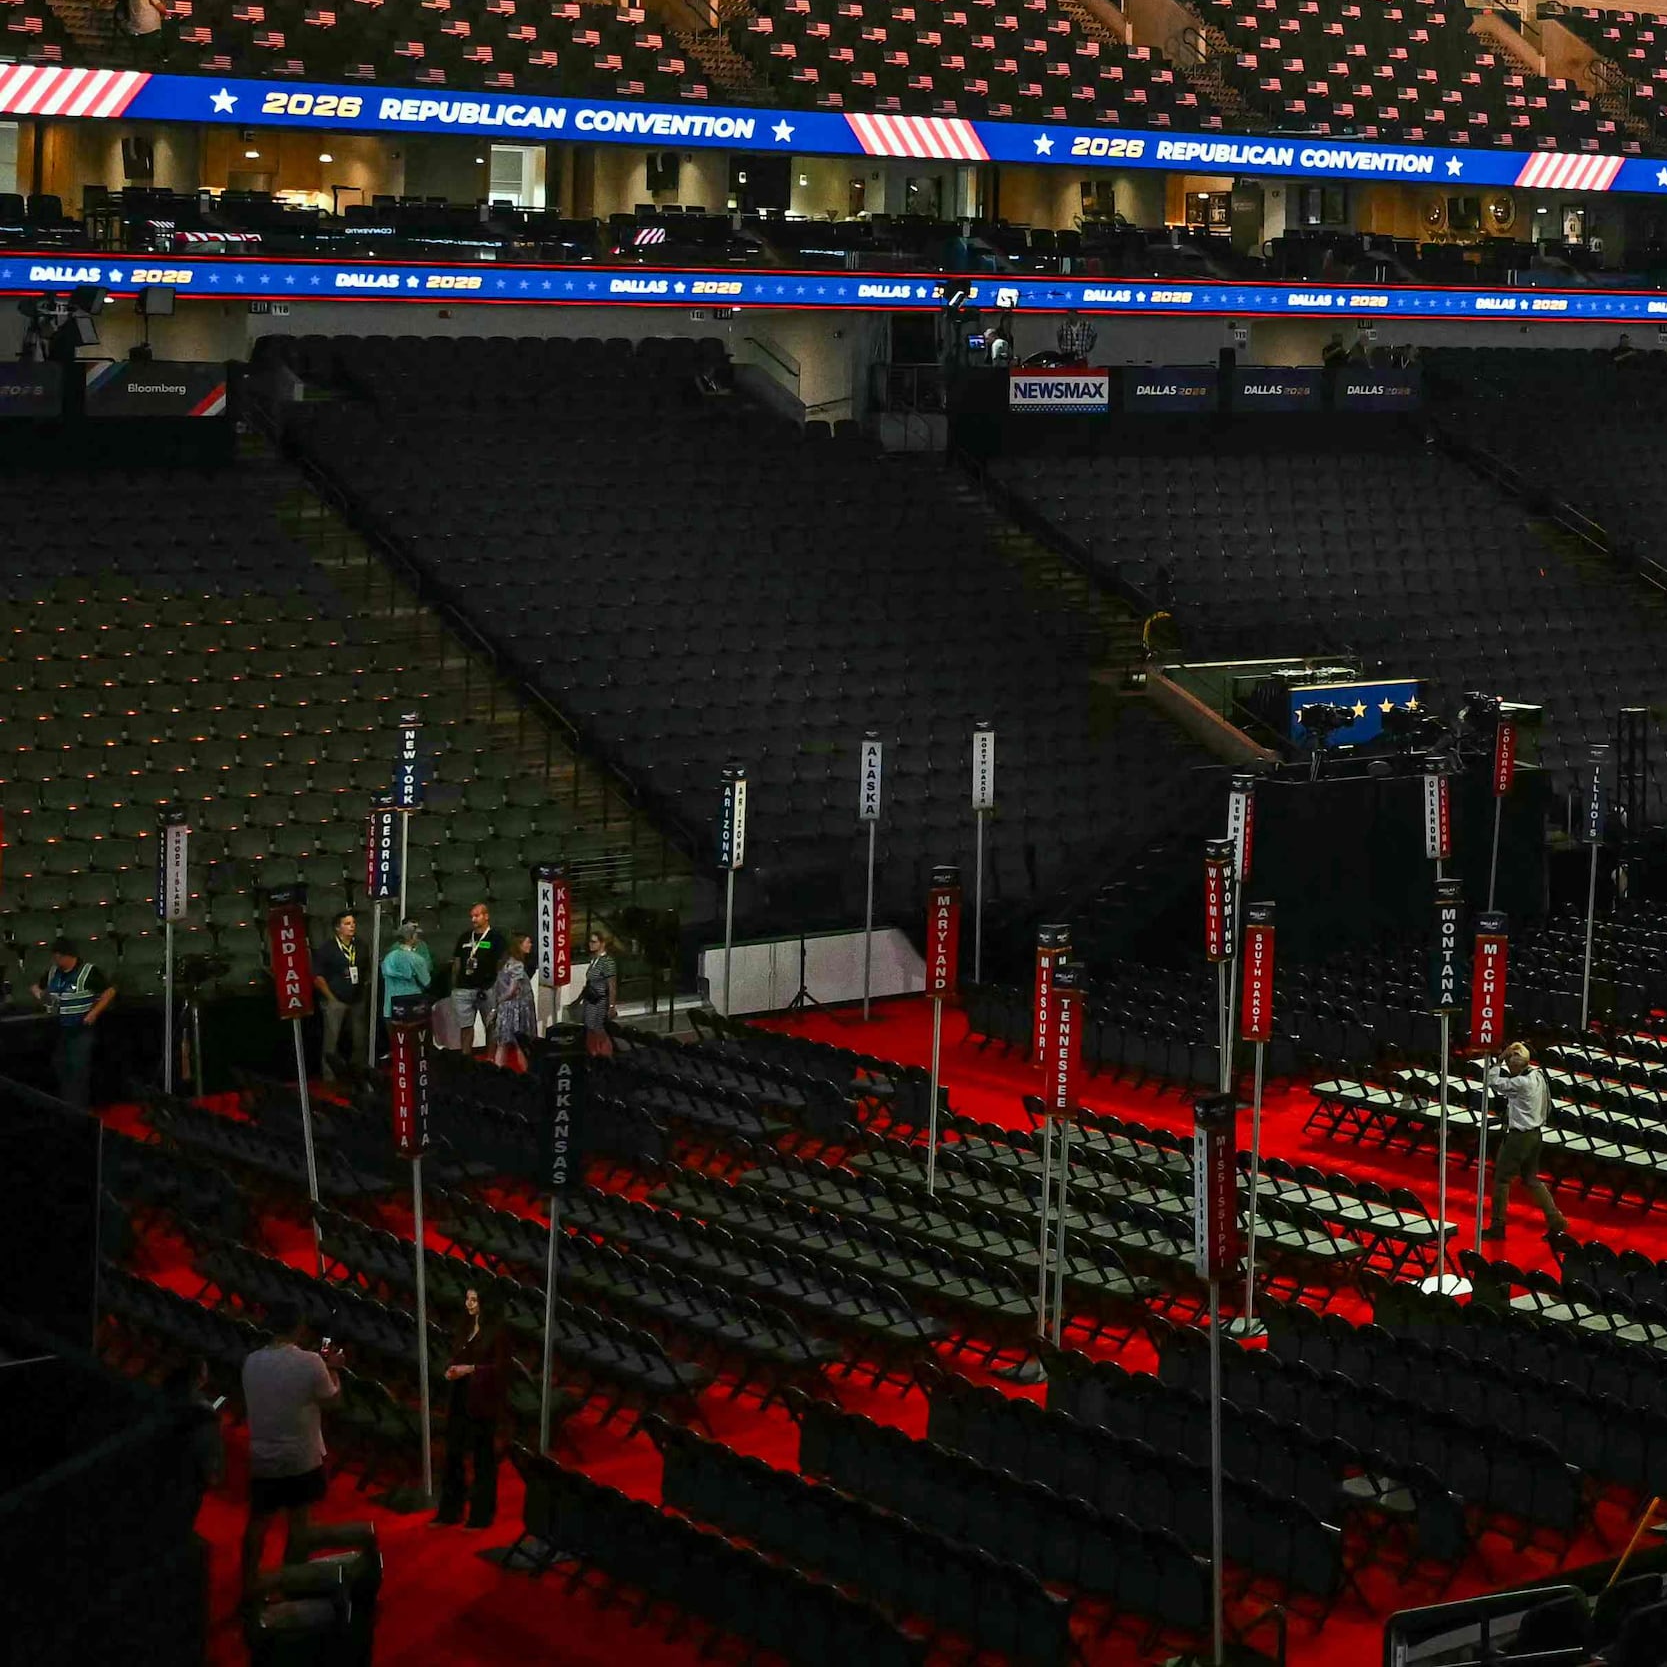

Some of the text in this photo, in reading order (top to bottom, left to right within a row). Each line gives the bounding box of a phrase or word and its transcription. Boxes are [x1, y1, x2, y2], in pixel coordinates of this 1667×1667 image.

[262, 91, 757, 140] 2026 REPUBLICAN CONVENTION
[1070, 137, 1435, 174] 2026 REPUBLICAN CONVENTION
[30, 266, 194, 285] DALLAS 2026
[335, 274, 483, 290] DALLAS 2026
[610, 280, 743, 295] DALLAS 2026
[858, 284, 911, 299] DALLAS
[1083, 289, 1132, 304] DALLAS
[1286, 294, 1332, 307] DALLAS
[1475, 297, 1517, 310] DALLAS
[127, 383, 188, 396] Bloomberg
[1013, 382, 1105, 399] NEWSMAX
[1135, 385, 1177, 396] DALLAS
[1243, 385, 1283, 396] DALLAS
[1346, 385, 1385, 396] DALLAS
[402, 730, 417, 805] NEW YORK
[866, 746, 877, 813] ALASKA
[1499, 728, 1511, 791] COLORADO
[721, 787, 731, 863] ARIZONA
[1428, 780, 1437, 852] OKLAHOMA
[1439, 779, 1448, 851] OKLAHOMA
[1589, 766, 1600, 837] ILLINOIS
[379, 813, 392, 895] GEORGIA
[541, 889, 551, 979] KANSAS
[556, 887, 566, 979] KANSAS
[934, 895, 951, 989] MARYLAND
[1207, 867, 1218, 955] WYOMING
[1222, 865, 1232, 954] WYOMING
[279, 914, 303, 1010] INDIANA
[1251, 933, 1263, 1033] SOUTH DAKOTA
[1440, 908, 1457, 1004] MONTANA
[1039, 956, 1050, 1062] MISSOURI
[1480, 943, 1498, 1044] MICHIGAN
[417, 1029, 430, 1146] VIRGINIA
[1056, 998, 1072, 1107] TENNESSEE
[396, 1032, 409, 1147] VIRGINIA
[552, 1062, 570, 1184] ARKANSAS
[1215, 1135, 1227, 1269] MISSISSIPPI
